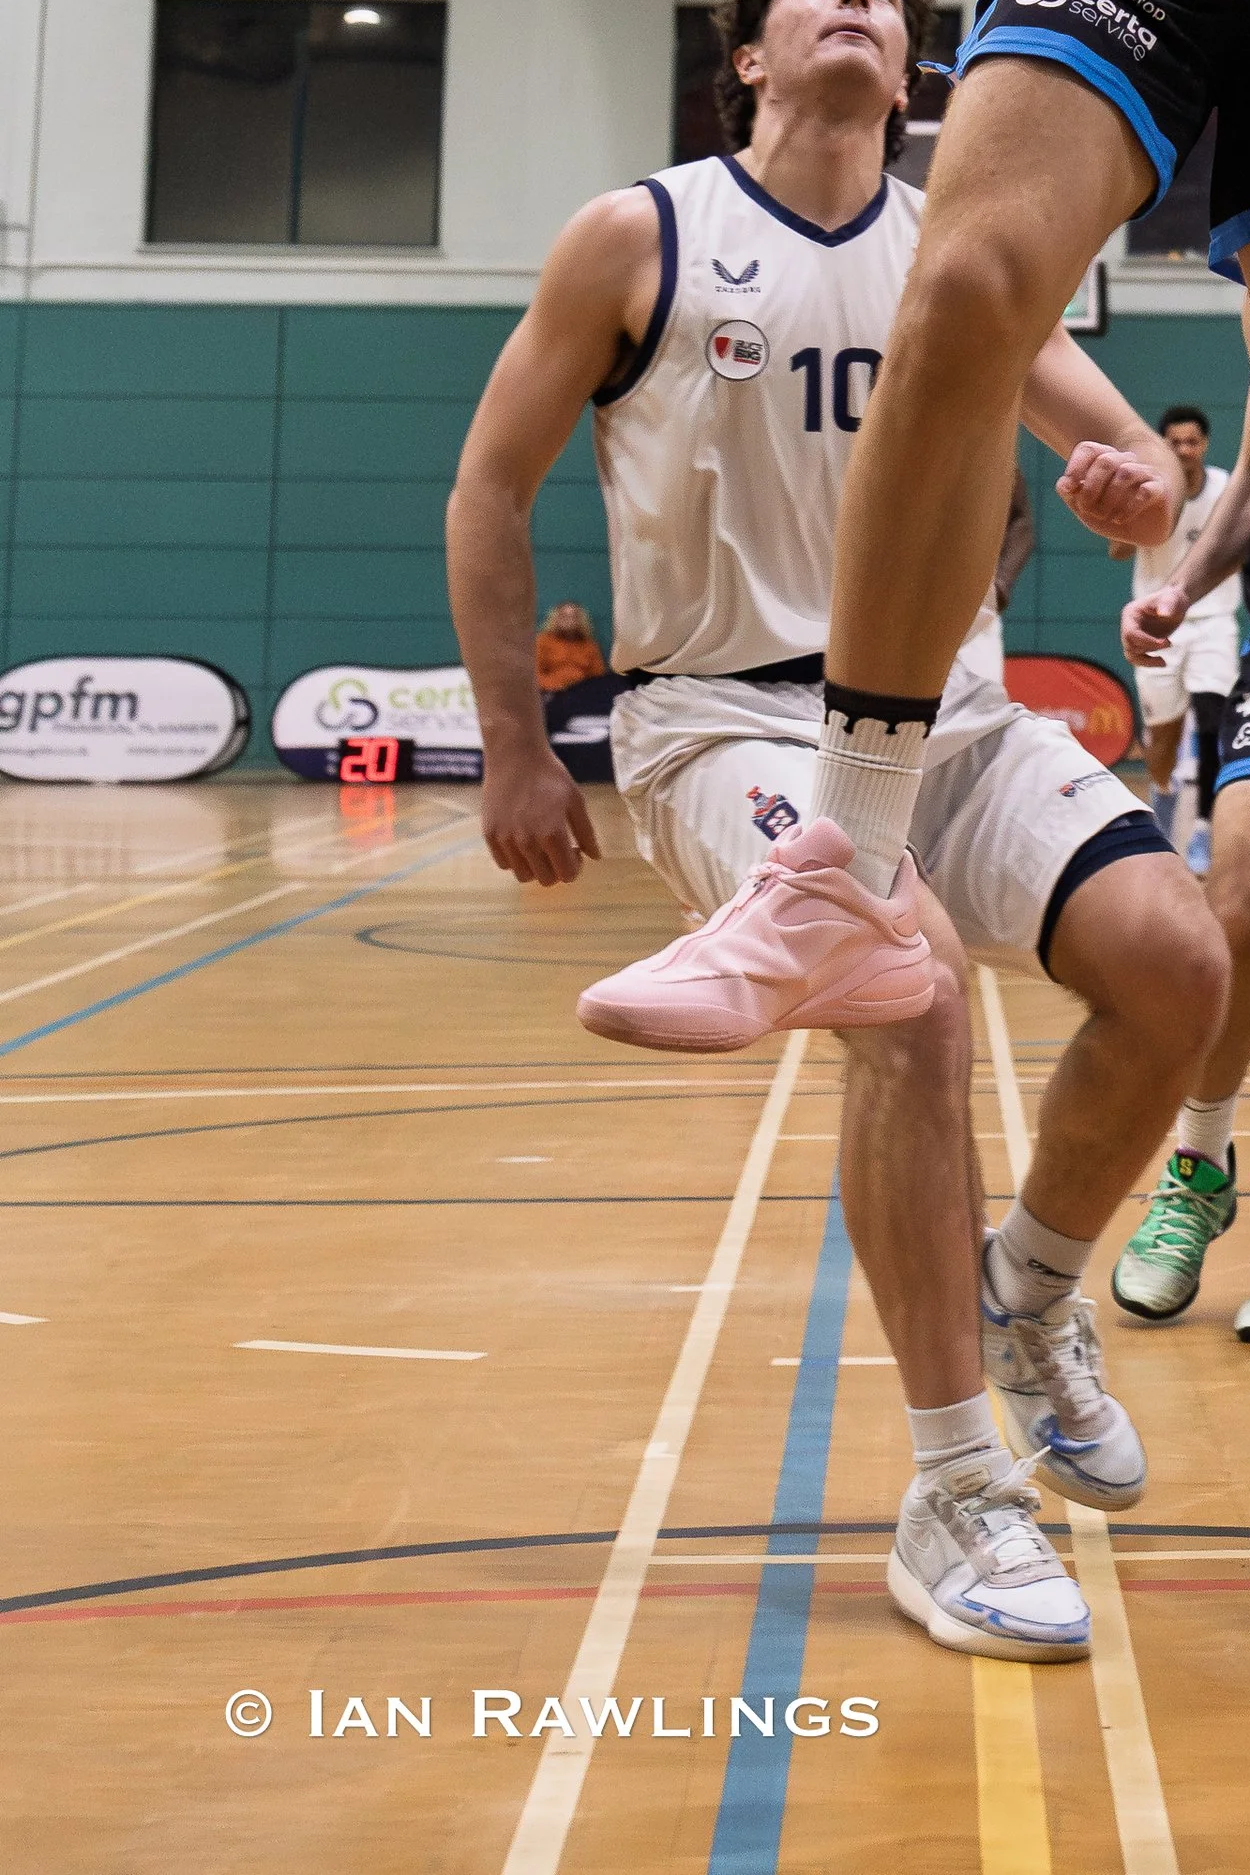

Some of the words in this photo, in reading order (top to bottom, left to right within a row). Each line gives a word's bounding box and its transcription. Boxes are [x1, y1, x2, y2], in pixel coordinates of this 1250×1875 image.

[1068, 0, 1147, 62] service
[790, 347, 883, 433] 10
[0, 675, 139, 733] gpfm
[387, 685, 474, 710] cert
[340, 737, 399, 782] 20
